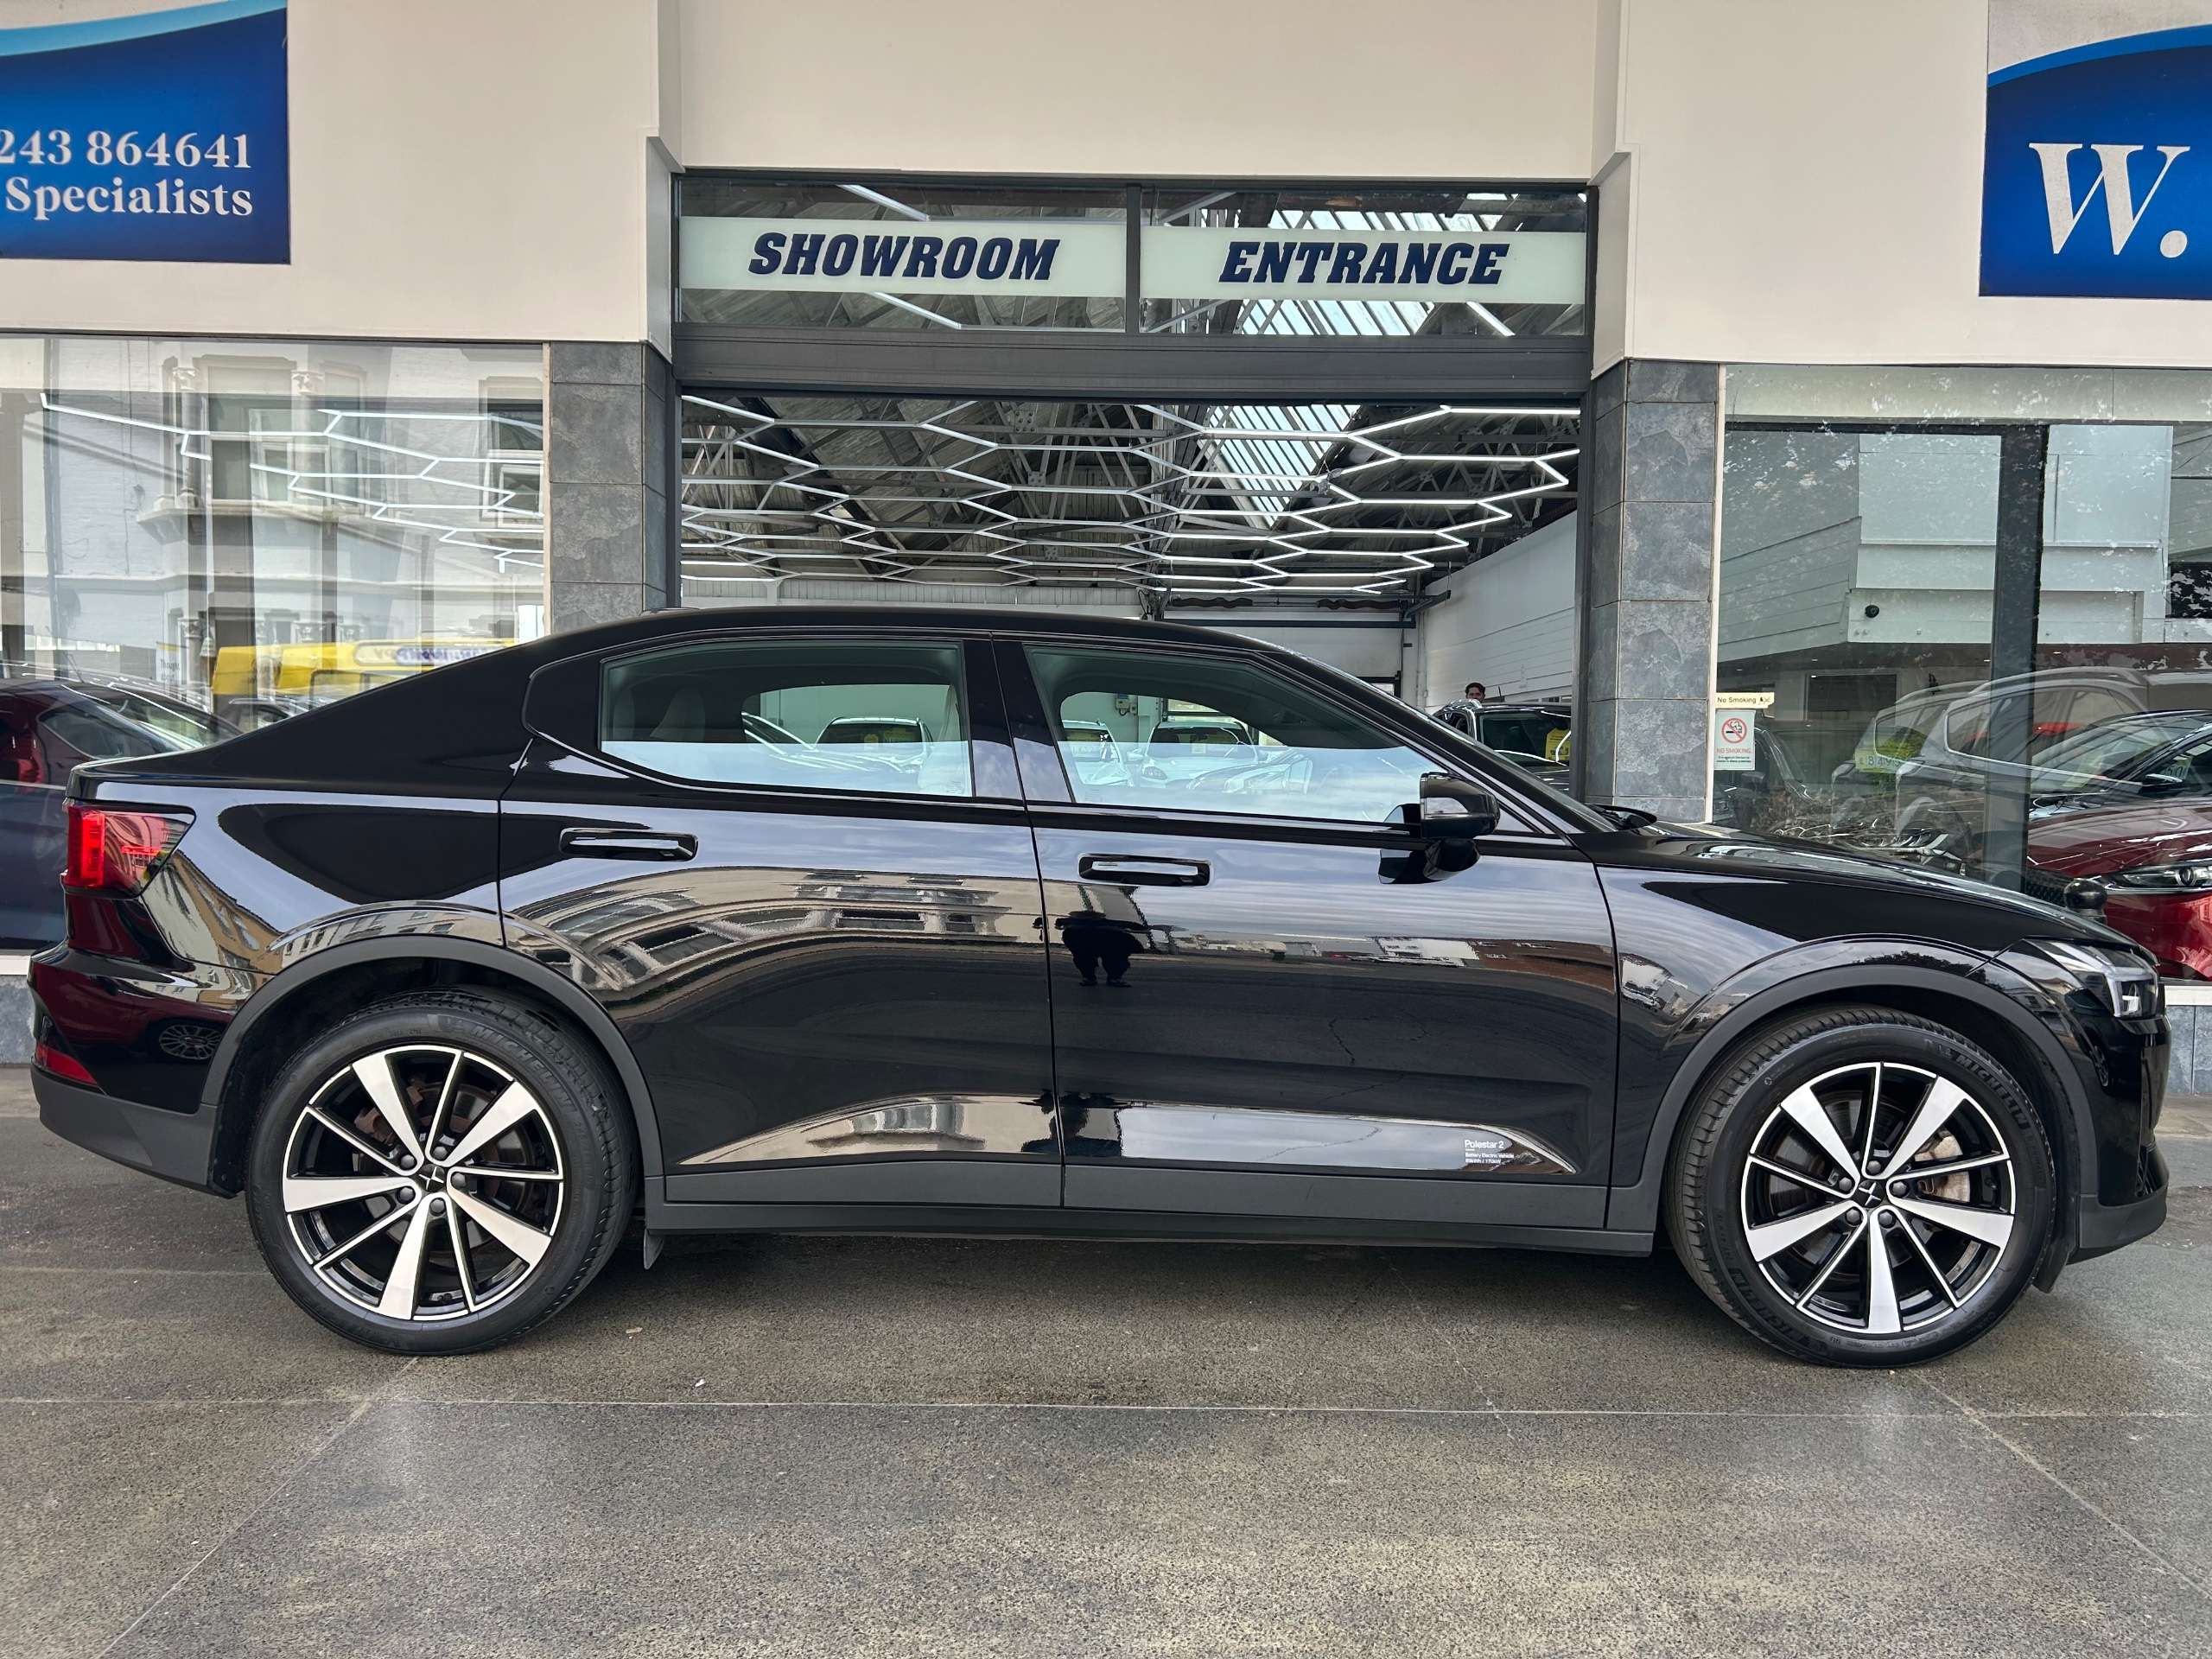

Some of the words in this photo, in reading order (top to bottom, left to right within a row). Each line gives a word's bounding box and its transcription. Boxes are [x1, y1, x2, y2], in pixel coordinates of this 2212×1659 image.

[0, 130, 72, 165] 243
[86, 130, 251, 168] 864641
[5, 176, 253, 220] Specialists
[2028, 142, 2190, 258] W.
[747, 232, 1061, 281] SHOWROOM
[1218, 241, 1510, 285] ENTRANCE
[474, 1023, 578, 1112] MICHELIN
[1956, 1055, 2031, 1129] MICHELIN
[1464, 1139, 1497, 1149] Polestar
[1498, 1140, 1504, 1149] 2
